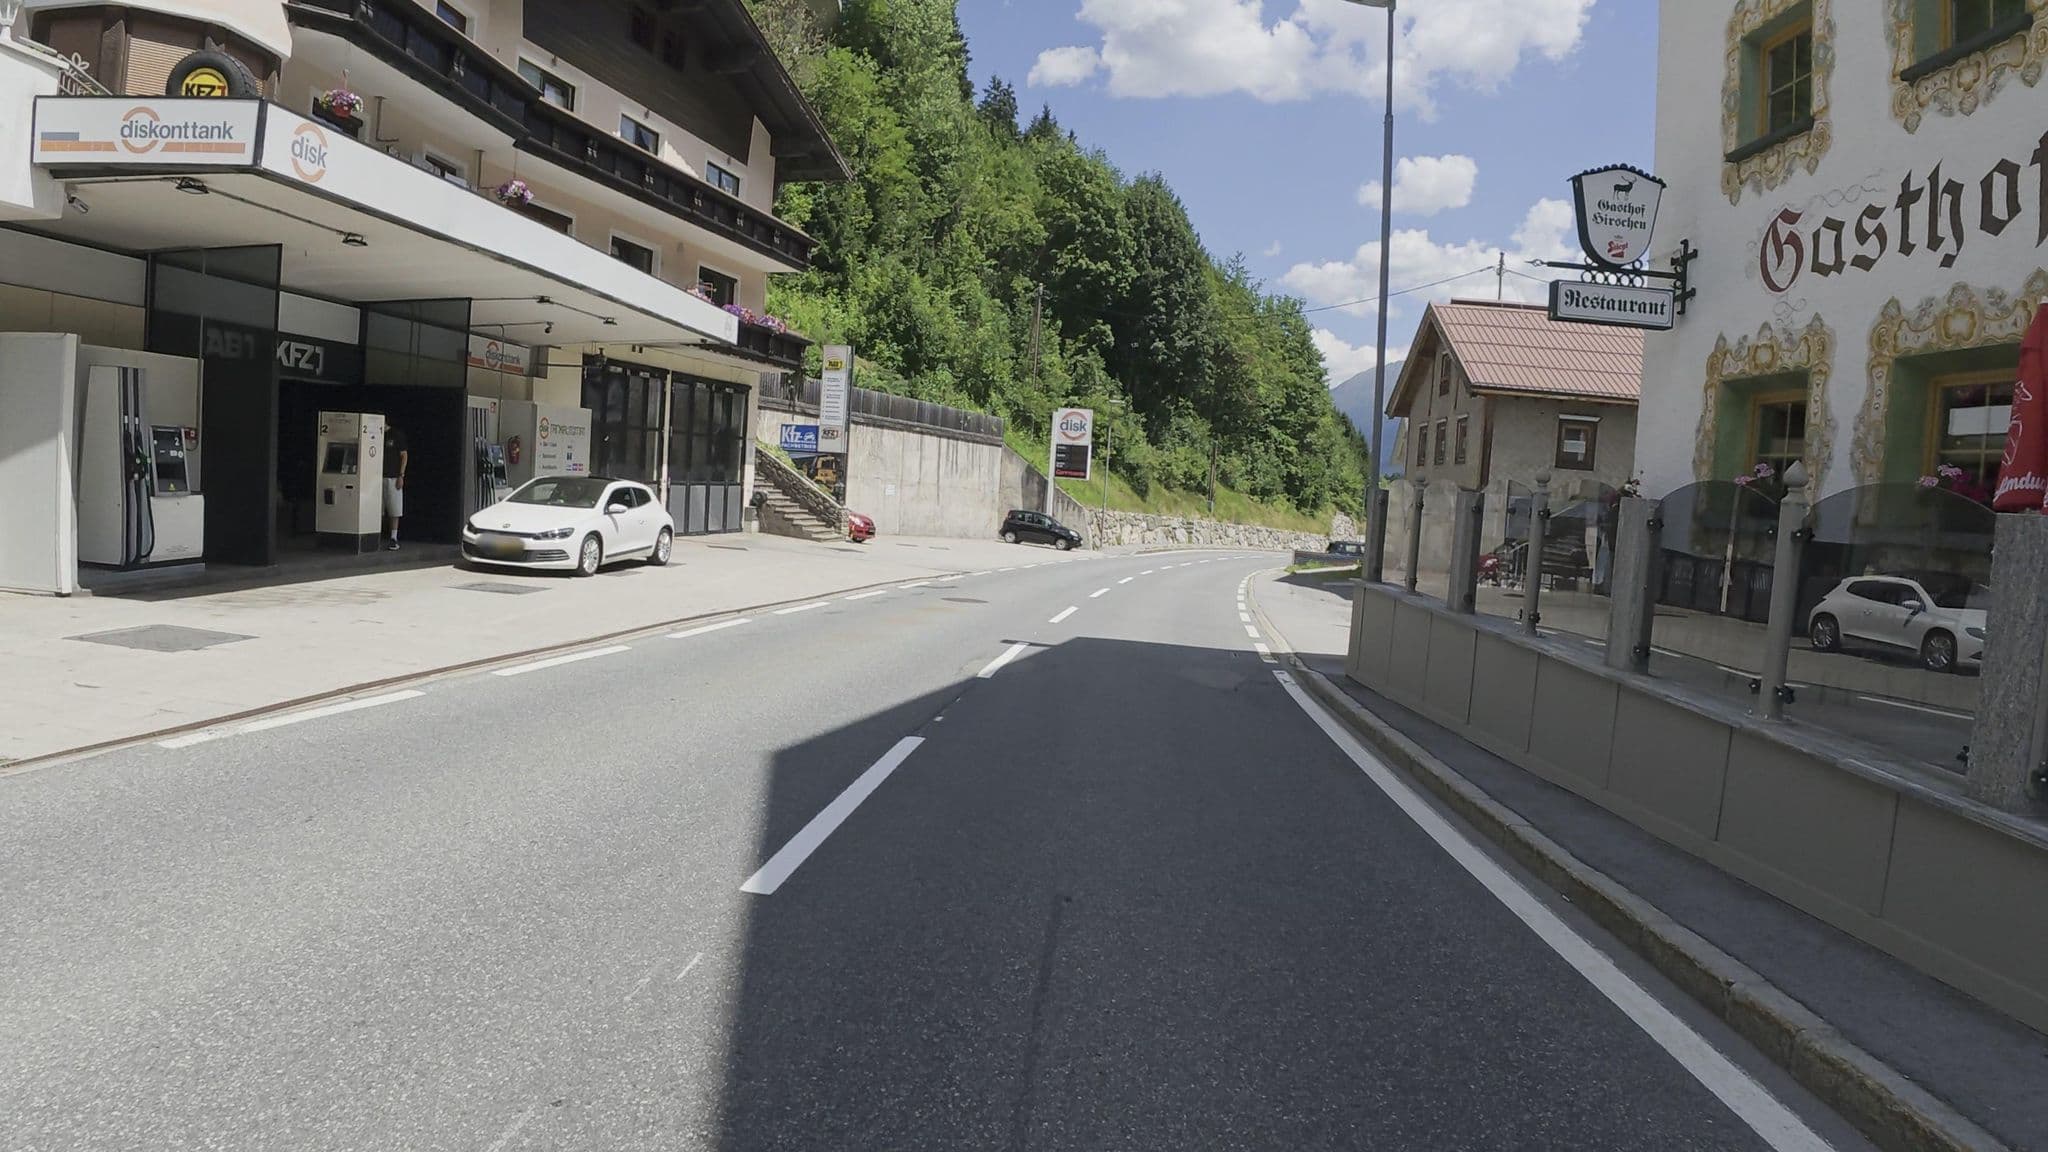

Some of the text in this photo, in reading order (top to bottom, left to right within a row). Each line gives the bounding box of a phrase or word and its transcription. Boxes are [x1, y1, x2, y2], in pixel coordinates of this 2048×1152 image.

[120, 120, 233, 140] diskonttank
[291, 136, 328, 168] disk
[1597, 199, 1646, 218] Gasthof
[1592, 211, 1647, 231] Hirschen
[1564, 288, 1667, 316] Restaurant
[322, 424, 329, 433] 2
[362, 425, 368, 434] 2
[1060, 419, 1087, 432] disk
[174, 436, 180, 446] 2
